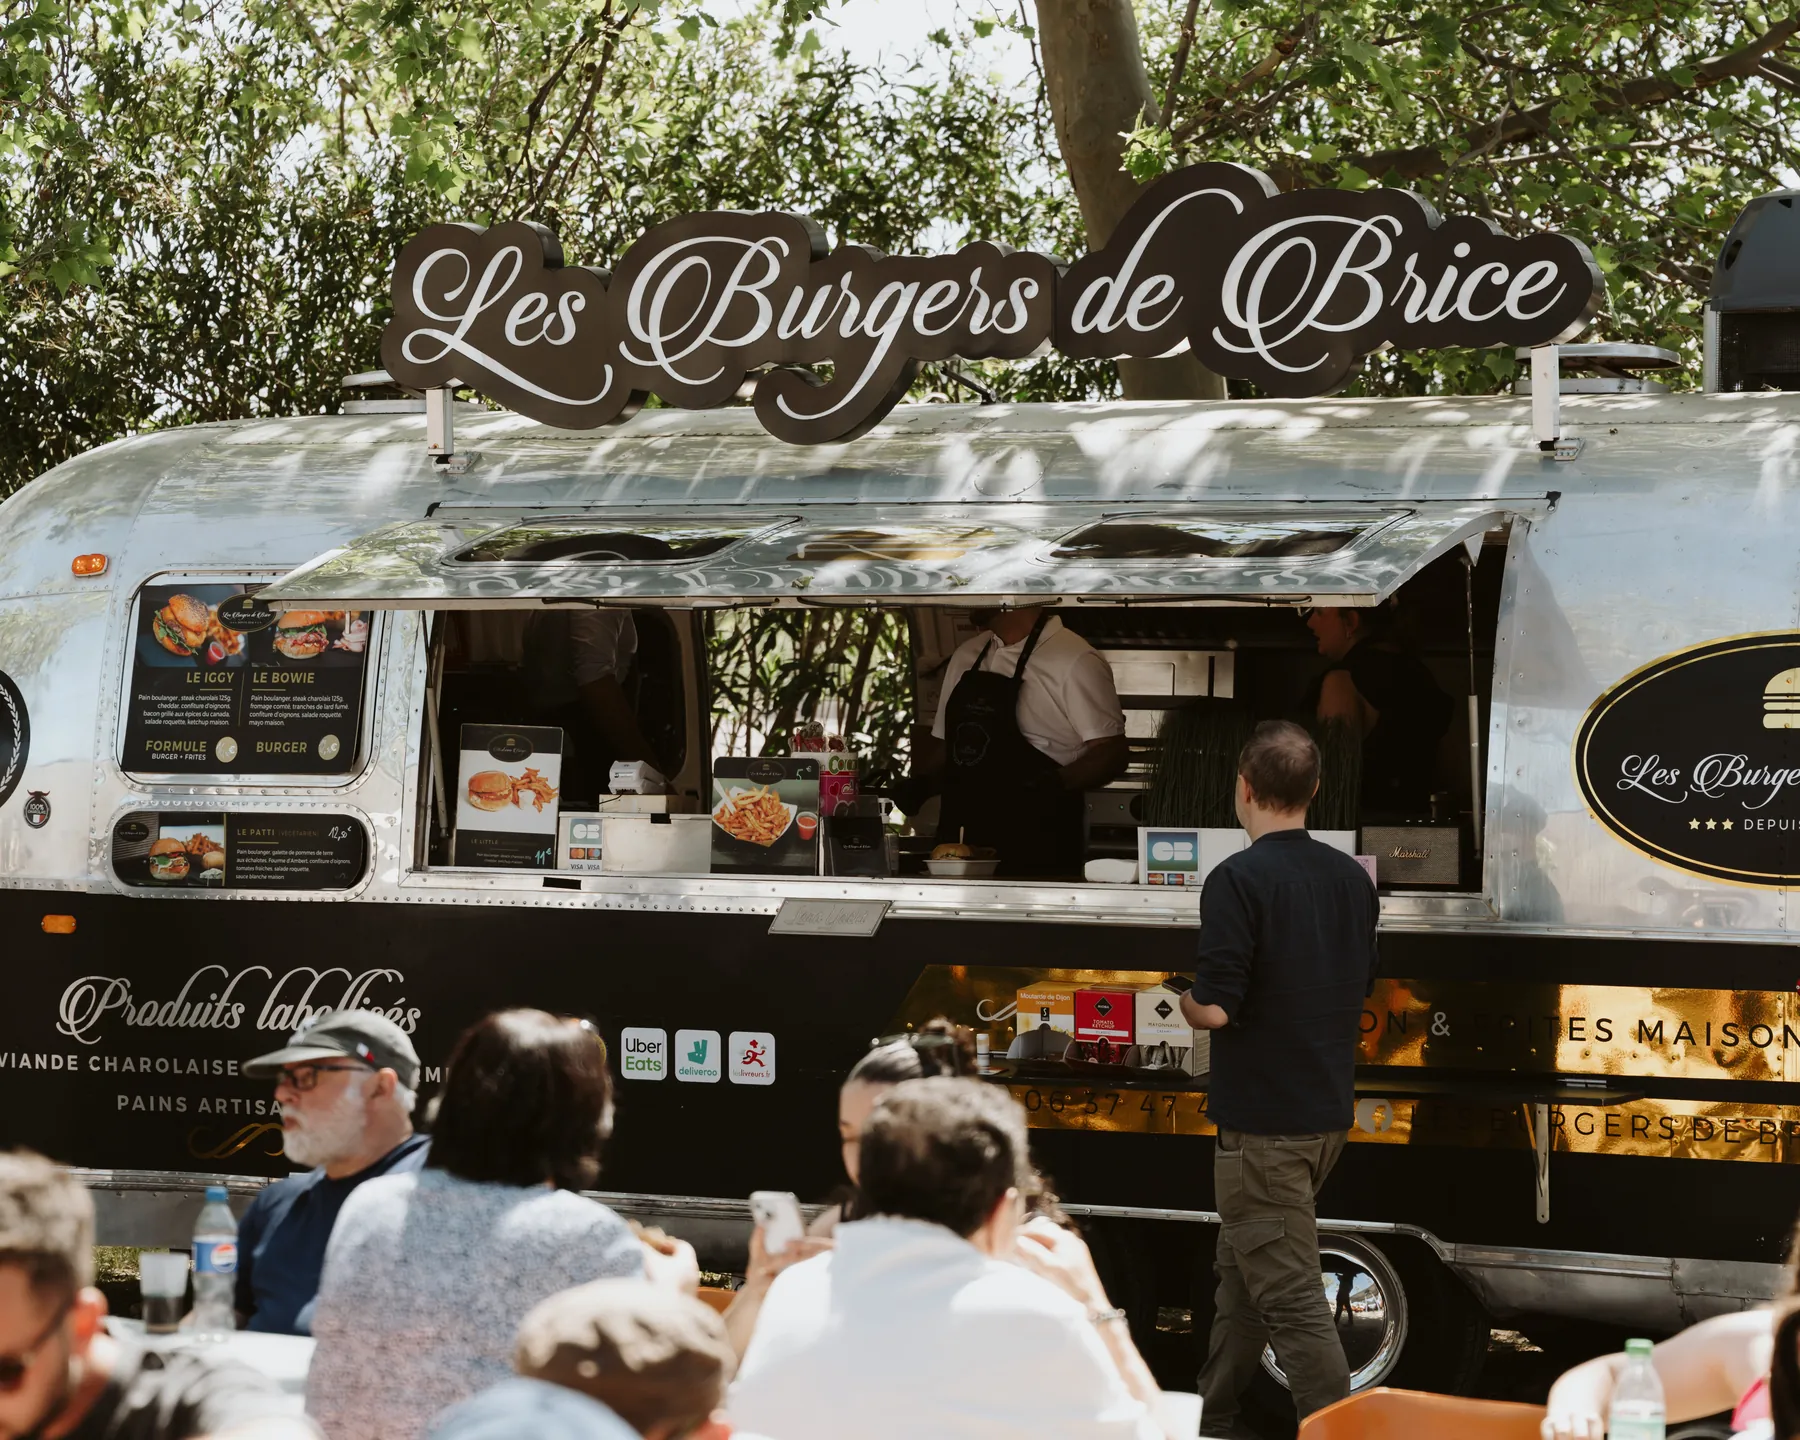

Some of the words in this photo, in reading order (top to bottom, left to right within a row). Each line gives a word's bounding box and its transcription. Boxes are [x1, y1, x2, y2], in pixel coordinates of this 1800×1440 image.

[402, 246, 613, 405] Les
[619, 236, 1039, 420] Burgers
[1071, 188, 1243, 333] de
[1212, 214, 1567, 373] Brice
[186, 672, 200, 683] LE
[204, 672, 234, 683] IGGY
[253, 672, 268, 684] LE
[272, 672, 315, 684] BOWIE
[146, 740, 207, 752] FORMULE
[256, 742, 307, 753] BURGER
[1616, 754, 1688, 804] Les
[1744, 819, 1800, 830] DEPUI
[1152, 842, 1193, 861] CB
[1389, 846, 1432, 859] Marshall
[56, 964, 272, 1045] Produits
[1431, 1012, 1451, 1036] &
[1638, 1019, 1800, 1049] MAISON
[625, 1038, 662, 1053] Uber
[0, 1052, 78, 1072] VIANDE
[88, 1056, 238, 1076] CHAROLAISE
[625, 1056, 662, 1071] Eats
[679, 1066, 718, 1077] deliveroo
[117, 1094, 188, 1112] PAINS
[1025, 1090, 1065, 1113] 06
[1084, 1092, 1120, 1115] 37
[1140, 1094, 1176, 1117] 47
[1693, 1116, 1741, 1143] DE
